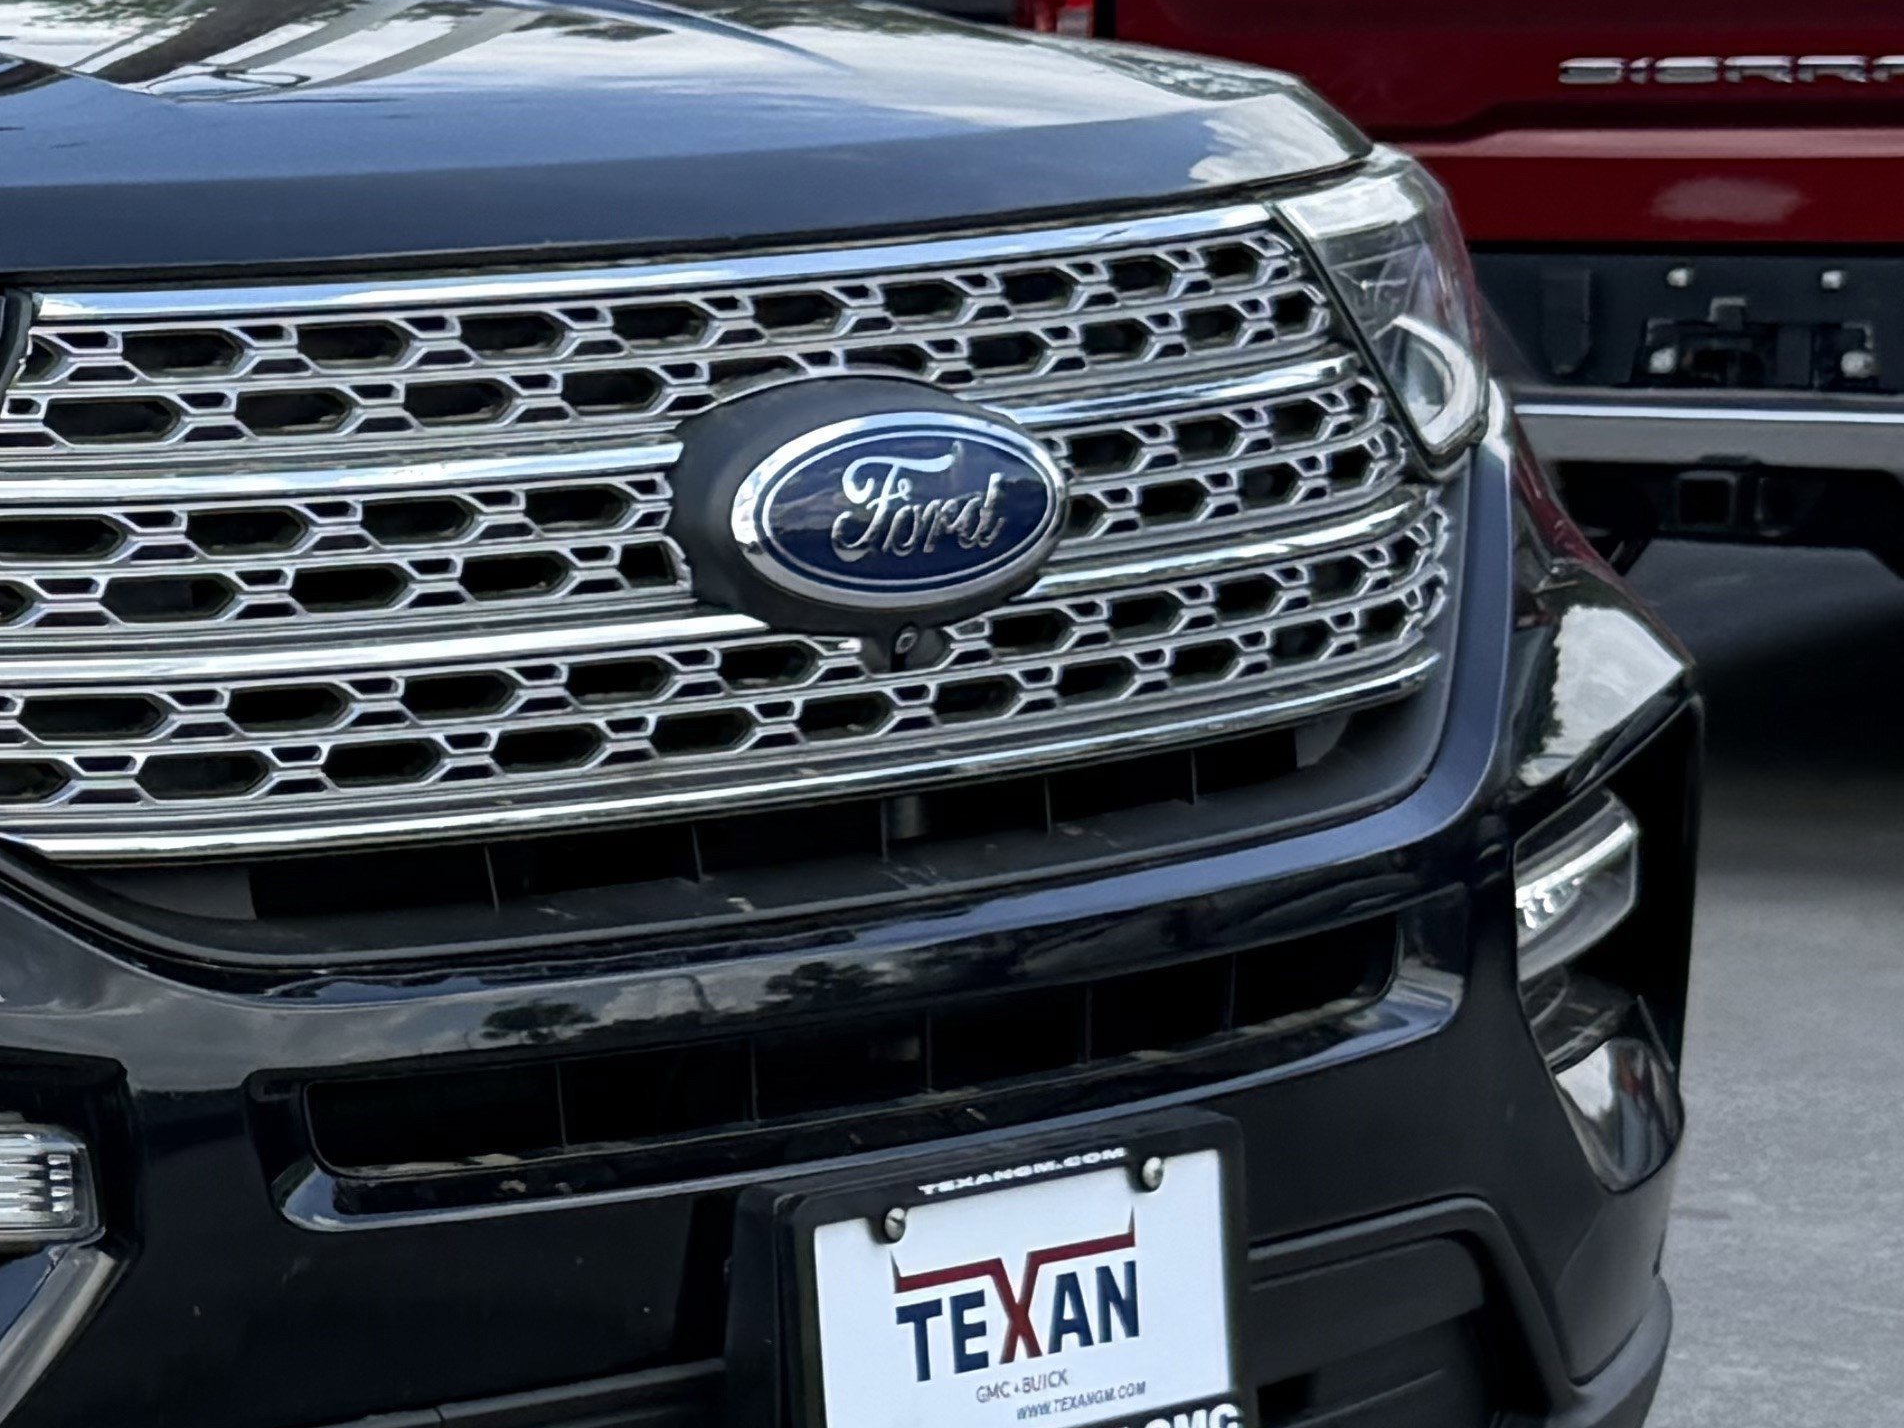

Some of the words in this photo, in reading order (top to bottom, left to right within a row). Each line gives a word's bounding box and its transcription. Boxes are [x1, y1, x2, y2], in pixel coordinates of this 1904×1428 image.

[831, 439, 1008, 564] Ford
[917, 1146, 1128, 1196] TEXANGM.COM
[894, 1248, 1141, 1383] TEXAN
[976, 1380, 1010, 1404] GMC
[1021, 1368, 1069, 1395] BUICK
[1016, 1380, 1147, 1420] WWW.TEXANGM.COM
